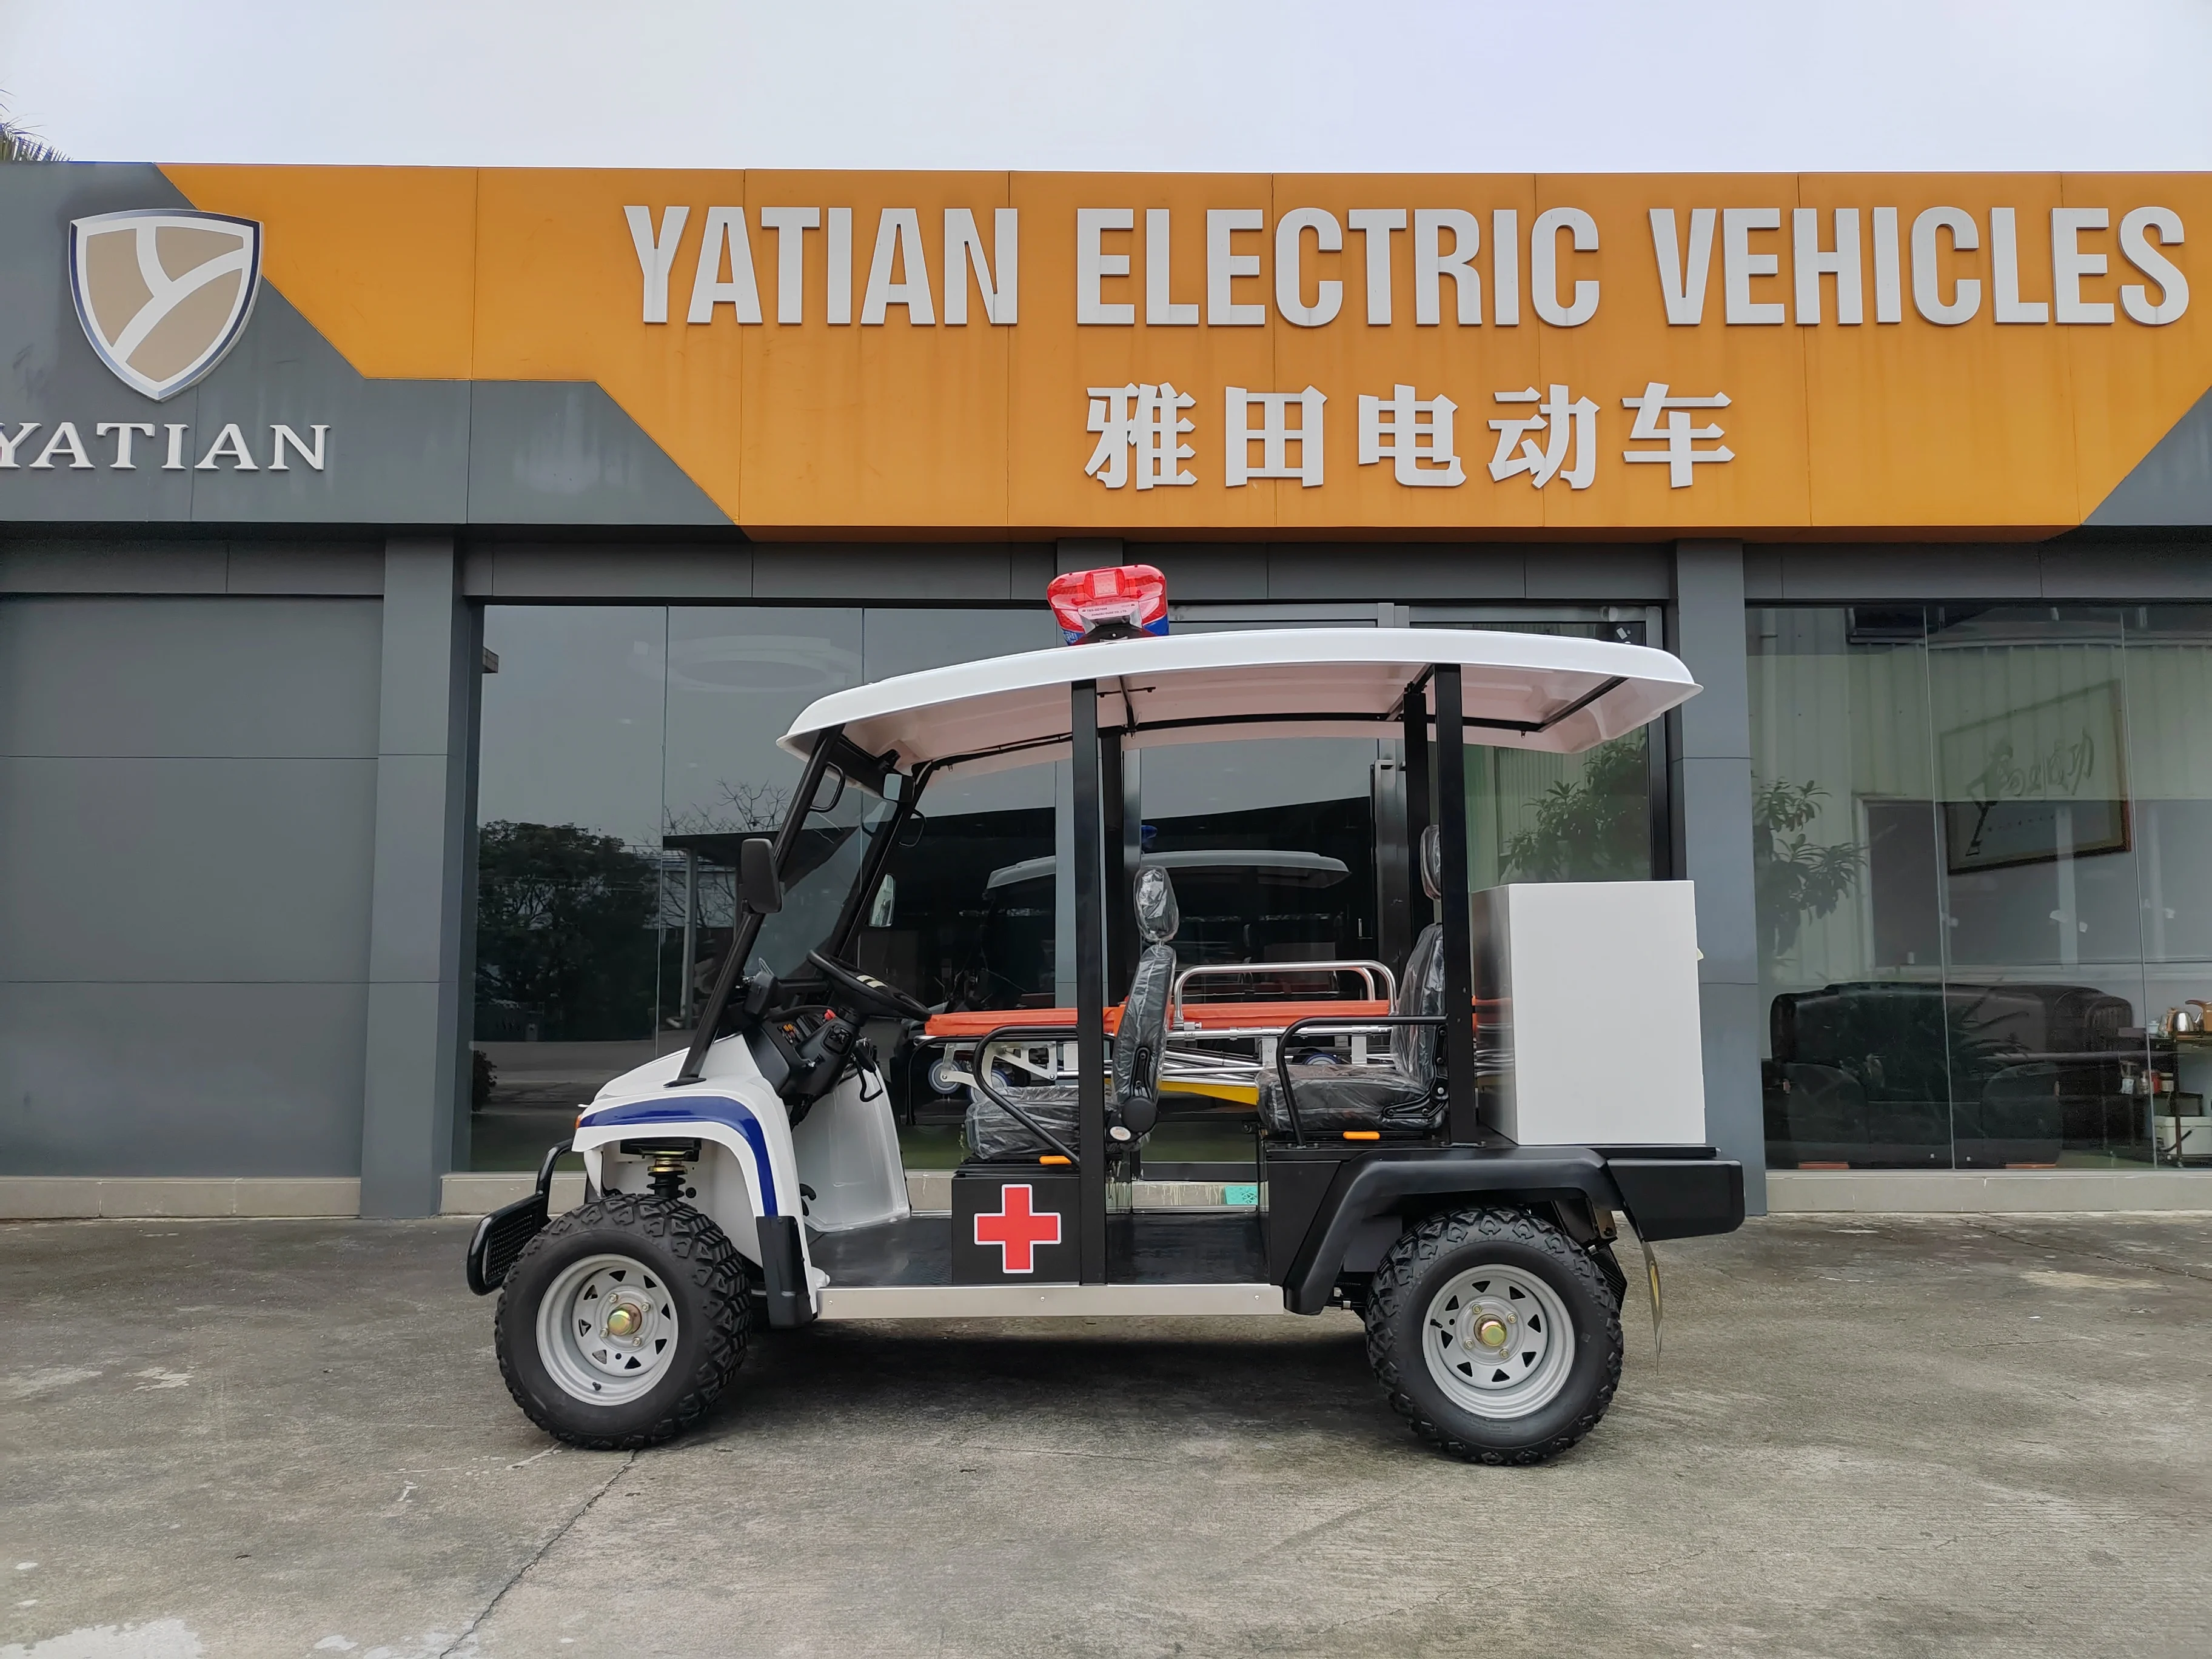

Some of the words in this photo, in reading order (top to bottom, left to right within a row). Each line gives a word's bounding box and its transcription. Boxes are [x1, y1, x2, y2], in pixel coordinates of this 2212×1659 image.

[623, 206, 1018, 326] YATIAN
[1077, 207, 1600, 328] ELECTRIC
[1648, 206, 2190, 327] VEHICLES
[0, 421, 331, 471] YATIAN
[1085, 381, 1735, 491] 雅田电动车
